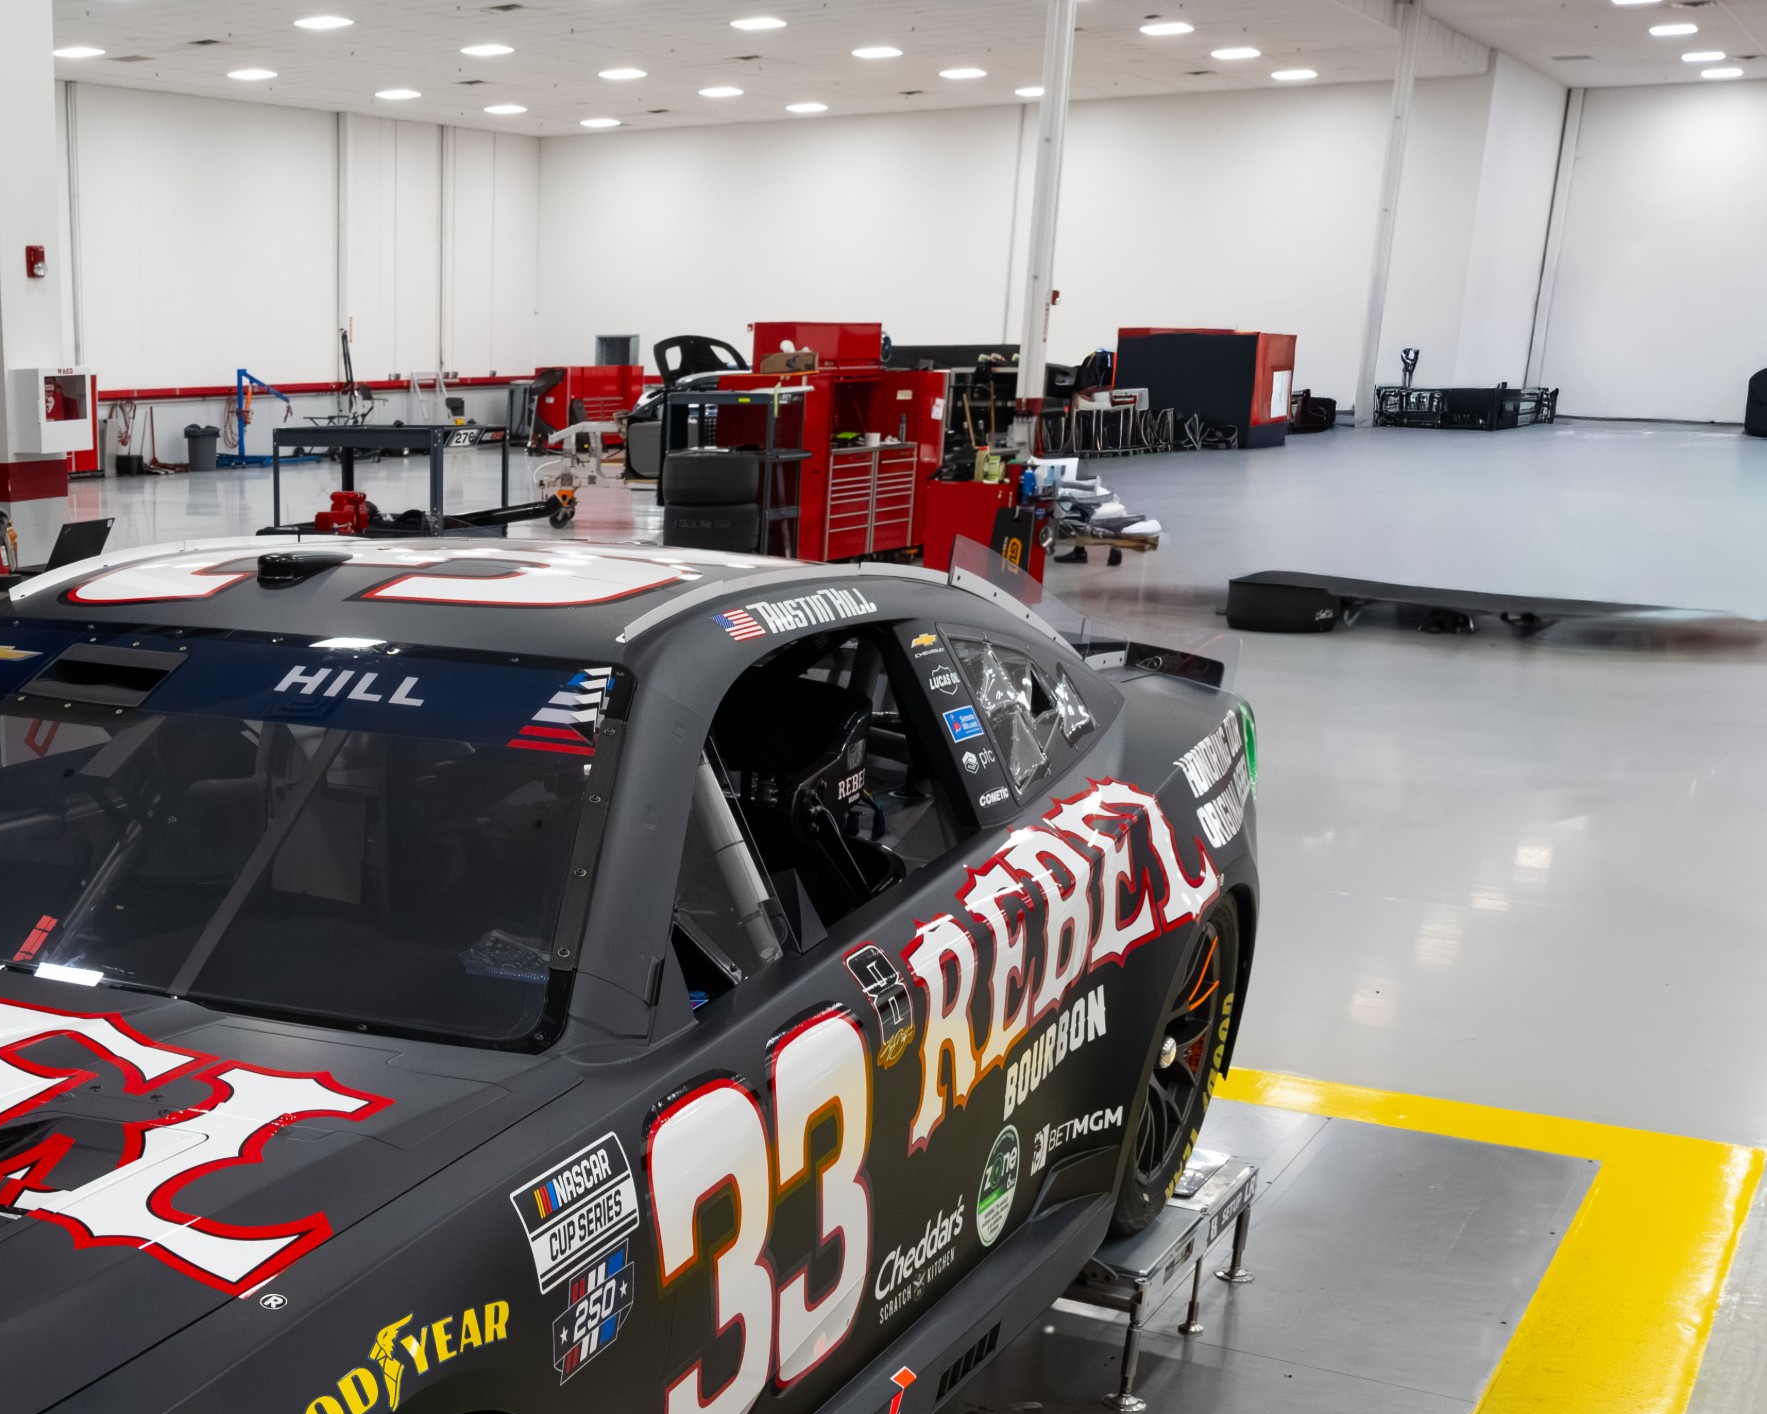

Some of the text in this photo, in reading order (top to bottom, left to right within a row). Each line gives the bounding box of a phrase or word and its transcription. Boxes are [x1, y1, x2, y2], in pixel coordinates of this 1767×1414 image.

[817, 587, 878, 620] HILL
[273, 664, 426, 708] HILL
[929, 675, 952, 691] LUCAS
[978, 747, 996, 770] ptc
[979, 786, 1010, 807] COMETIC
[899, 775, 1222, 1158] REBEL
[1002, 983, 1107, 1122] BOURBON
[551, 1147, 613, 1208] NASCAR
[548, 1188, 623, 1262] CUP SERIES
[874, 1193, 965, 1300] Cheddar's
[572, 1278, 617, 1343] 250
[878, 1246, 956, 1325] SCRATCH KITCHEN
